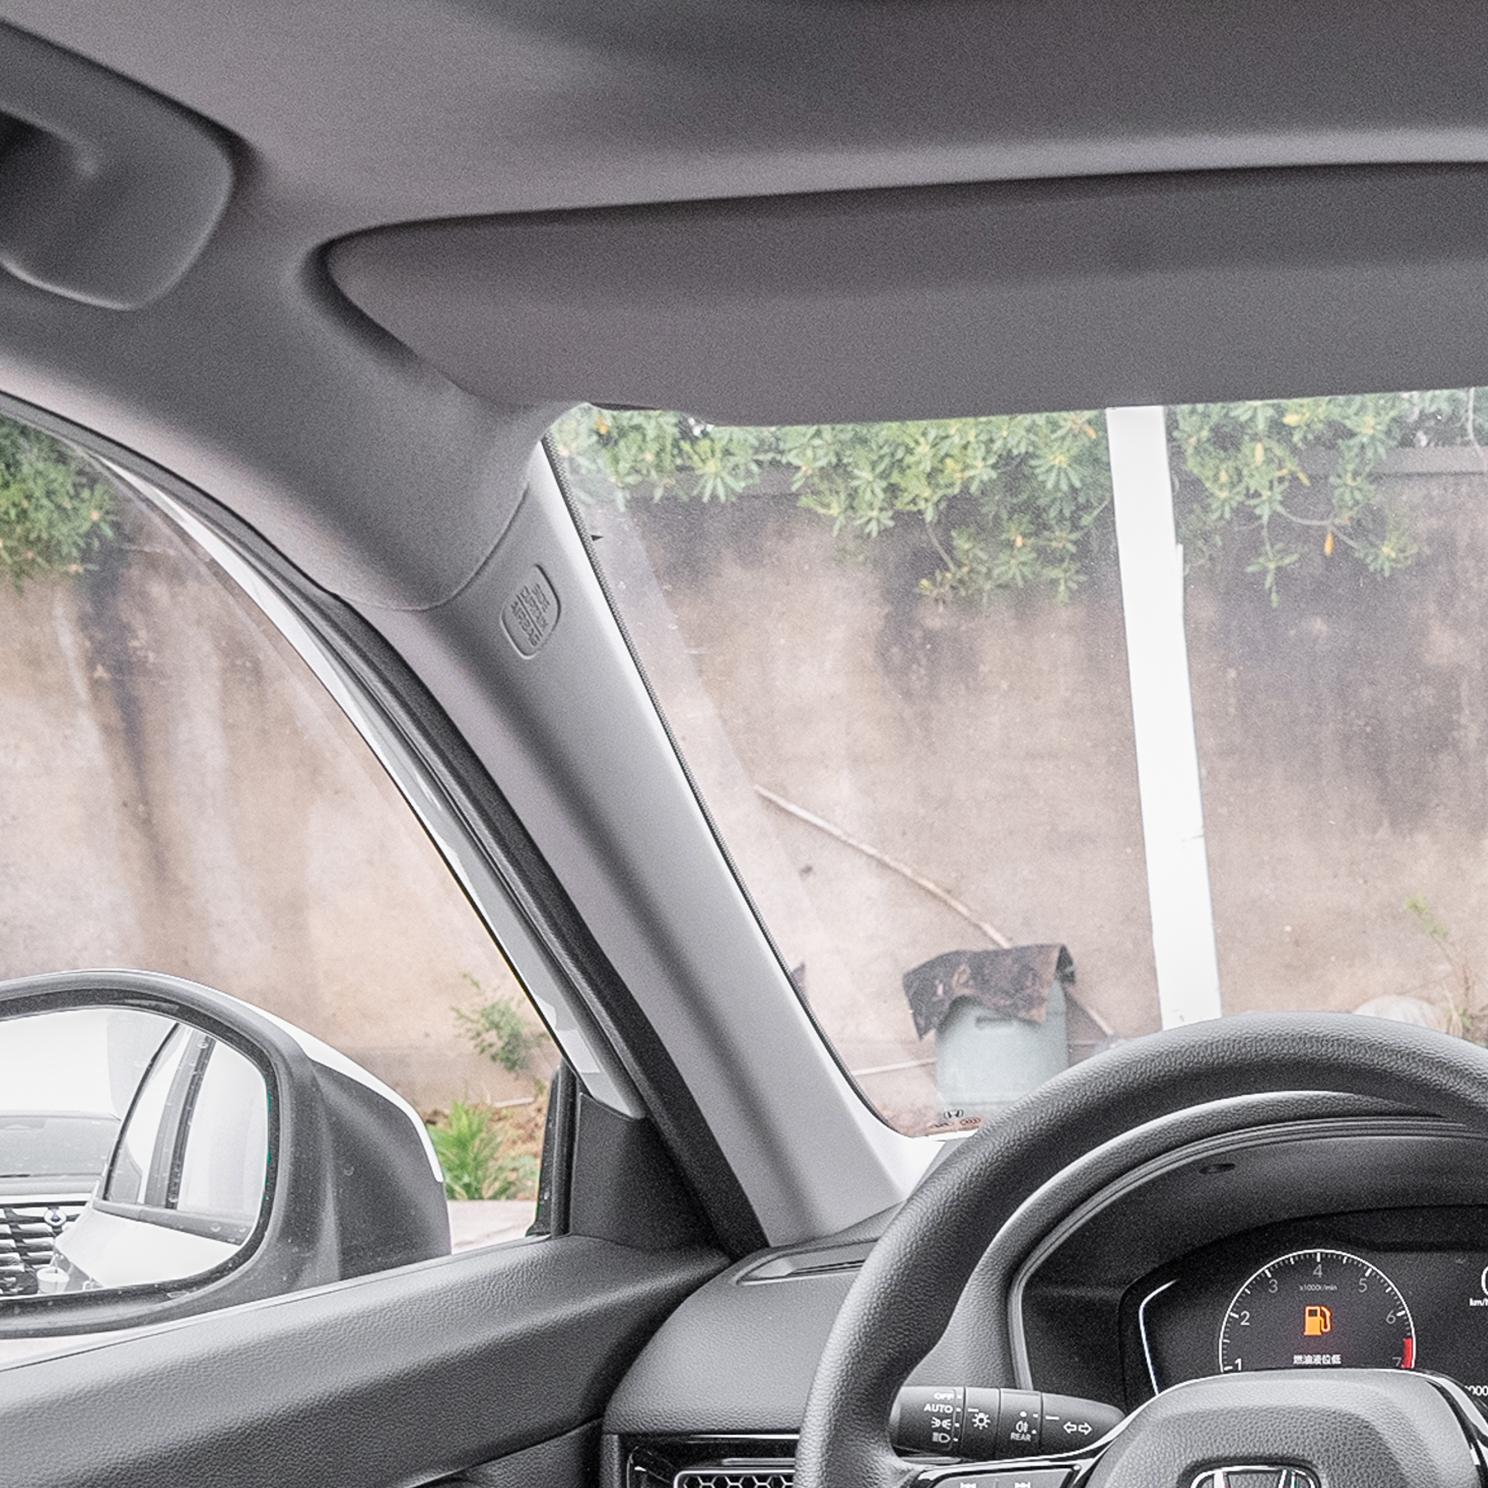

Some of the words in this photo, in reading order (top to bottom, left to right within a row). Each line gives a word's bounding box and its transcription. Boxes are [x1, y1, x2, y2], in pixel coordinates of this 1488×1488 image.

[1313, 1264, 1323, 1278] 4
[1268, 1280, 1278, 1293] 3
[1358, 1278, 1368, 1292] 5
[1240, 1311, 1250, 1325] 2
[1385, 1311, 1396, 1324] 6
[1234, 1358, 1242, 1371] 1
[924, 1404, 953, 1413] AUTO
[1010, 1433, 1031, 1441] REAR
